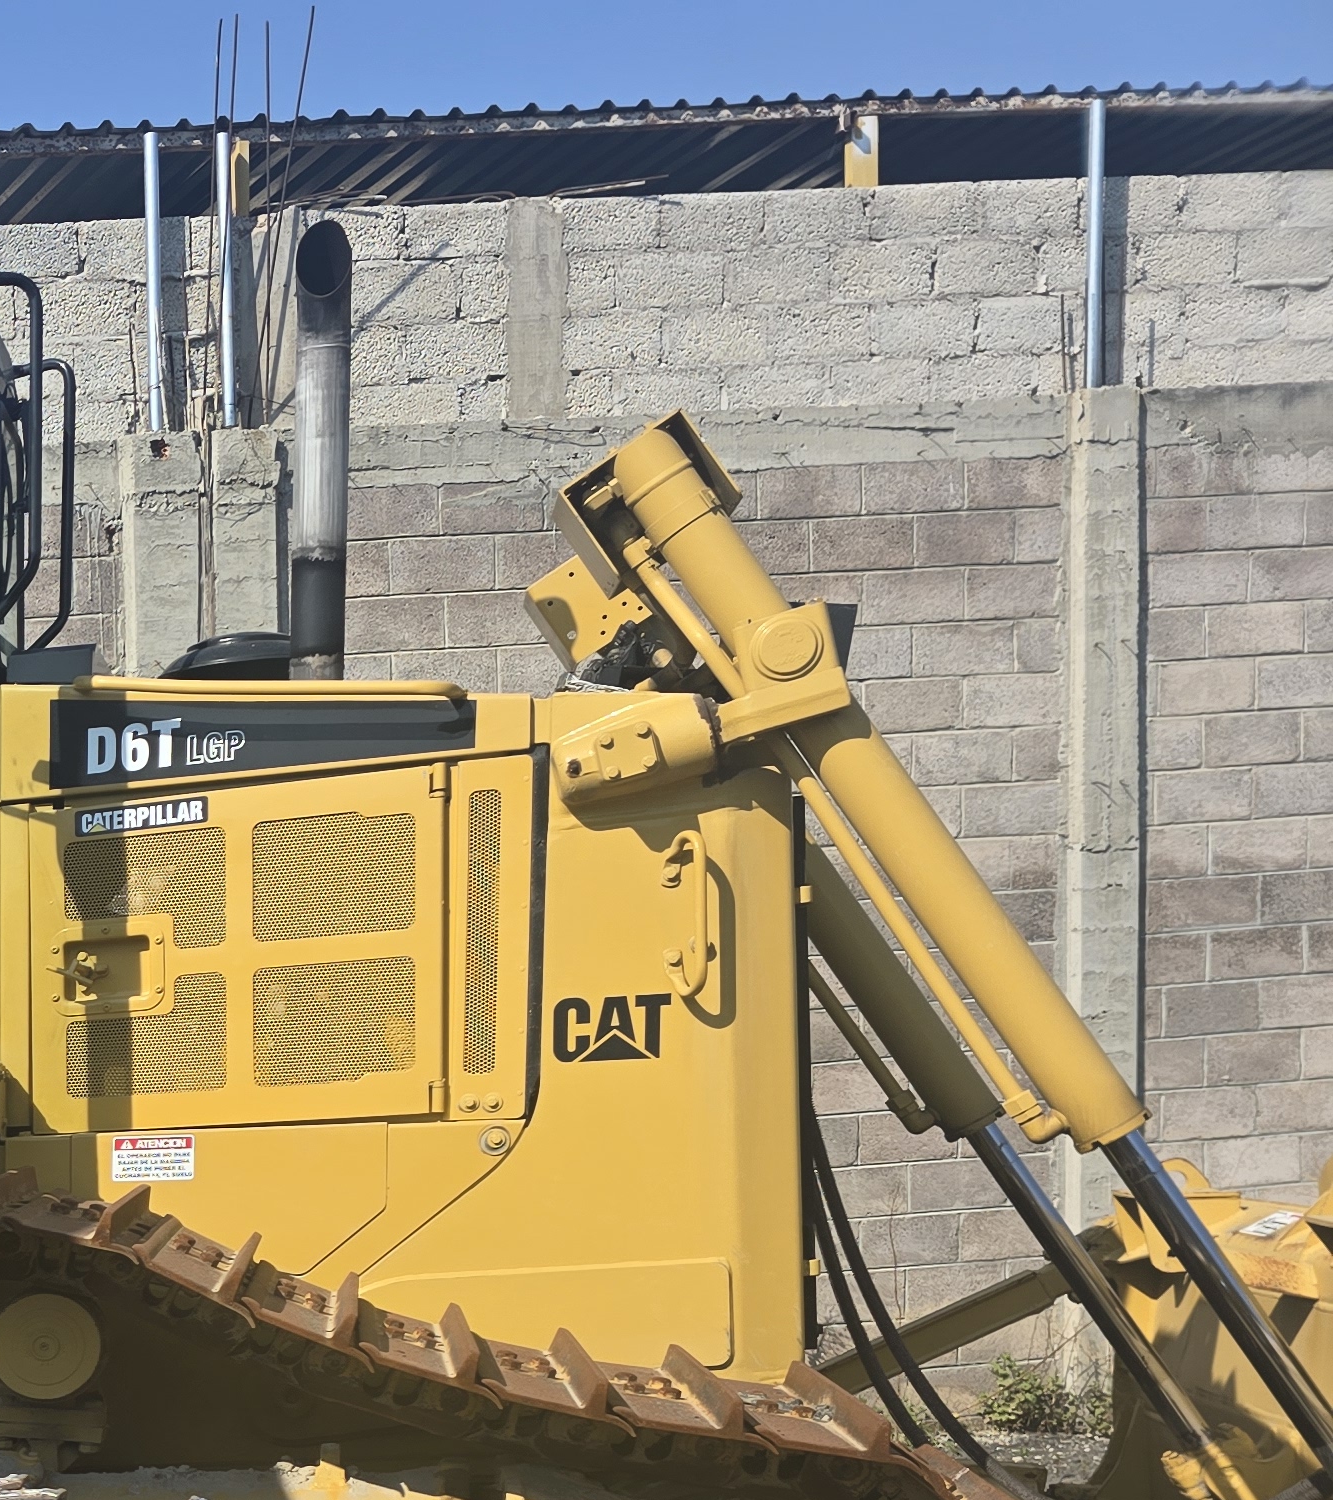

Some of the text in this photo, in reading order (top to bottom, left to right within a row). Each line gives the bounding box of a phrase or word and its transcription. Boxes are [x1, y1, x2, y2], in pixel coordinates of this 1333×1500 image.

[87, 717, 246, 775] D6T LGP
[81, 800, 204, 834] CATERPILLAR
[553, 993, 672, 1063] CAT
